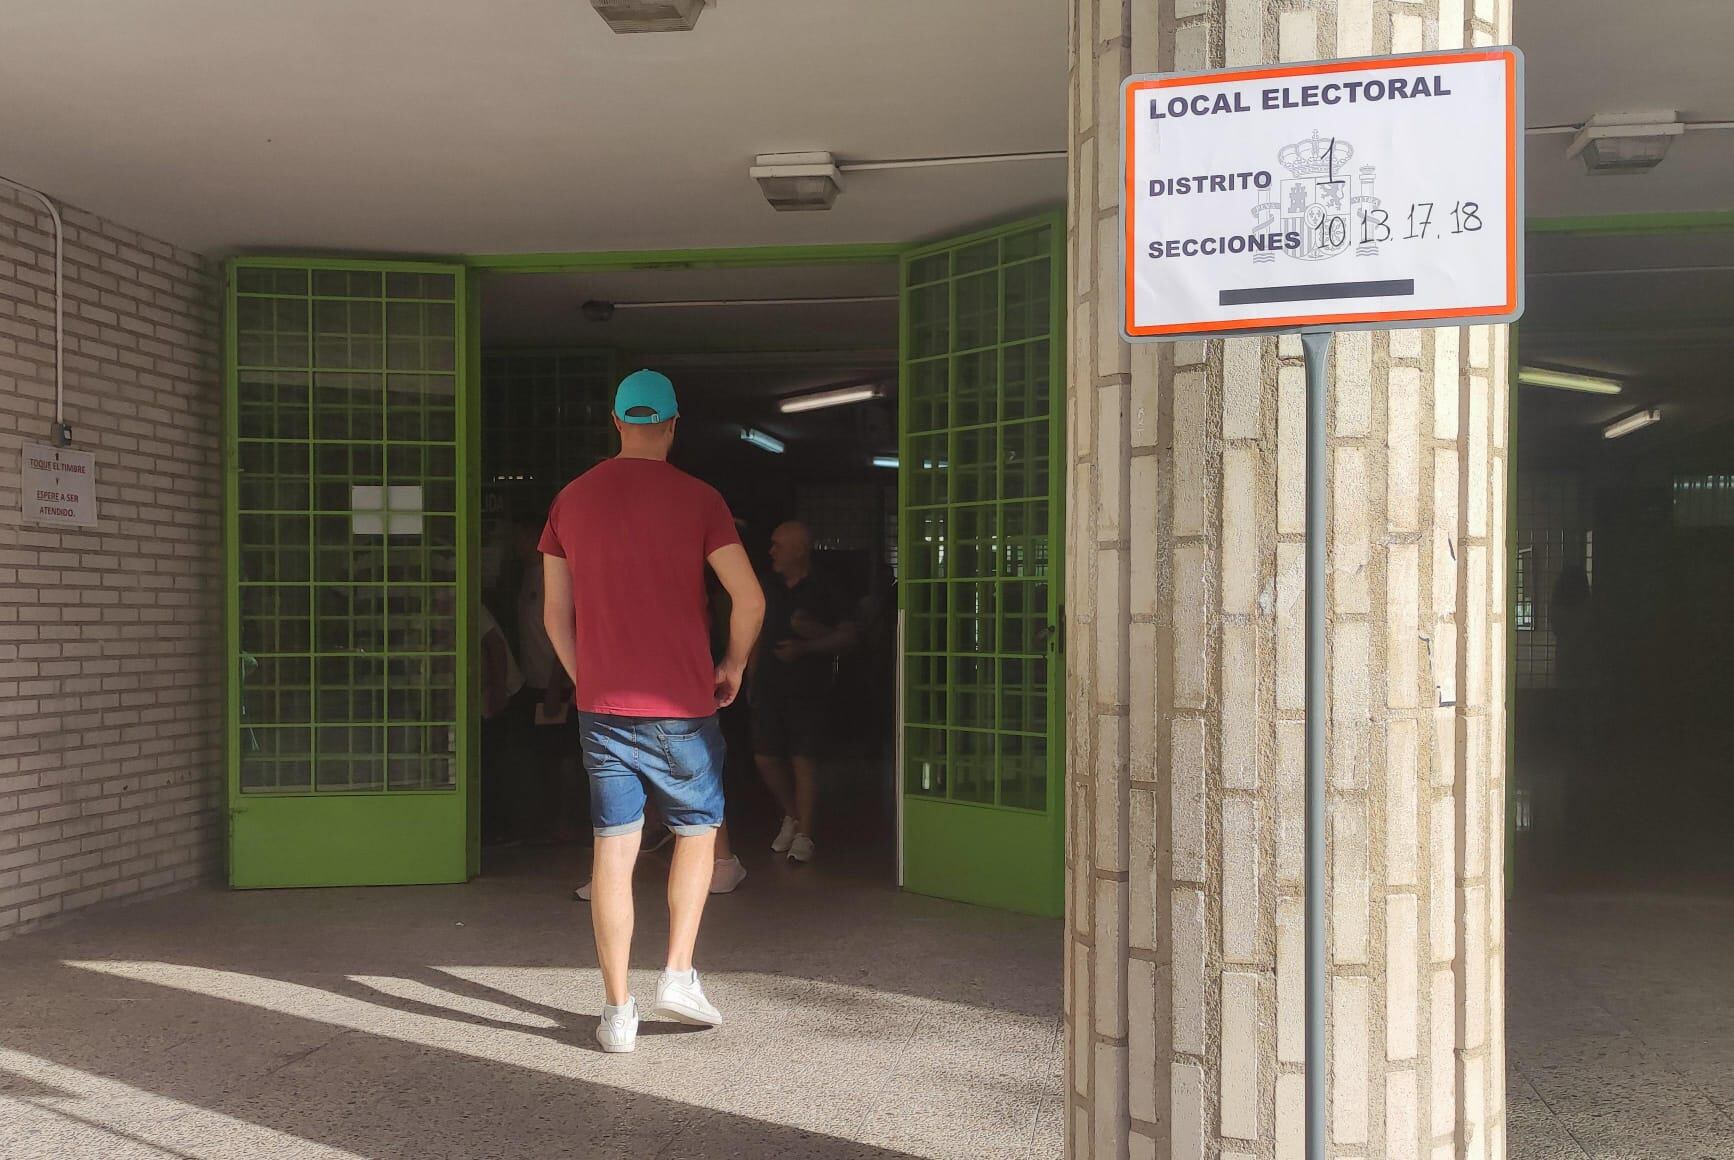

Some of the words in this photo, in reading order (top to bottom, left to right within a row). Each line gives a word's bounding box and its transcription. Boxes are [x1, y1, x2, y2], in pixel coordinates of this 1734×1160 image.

[1149, 91, 1251, 119] LOCAL
[1262, 75, 1452, 110] ELECTORAL
[1149, 170, 1272, 197] DISTRITO
[1316, 136, 1346, 185] 1
[1148, 231, 1301, 259] SECCIONES
[1450, 200, 1483, 234] 18
[30, 459, 52, 471] TOQUE
[53, 462, 61, 471] EL
[61, 464, 86, 474] TIMBRE
[36, 490, 58, 501] ESPERE
[60, 494, 66, 502] A
[66, 494, 79, 504] SER
